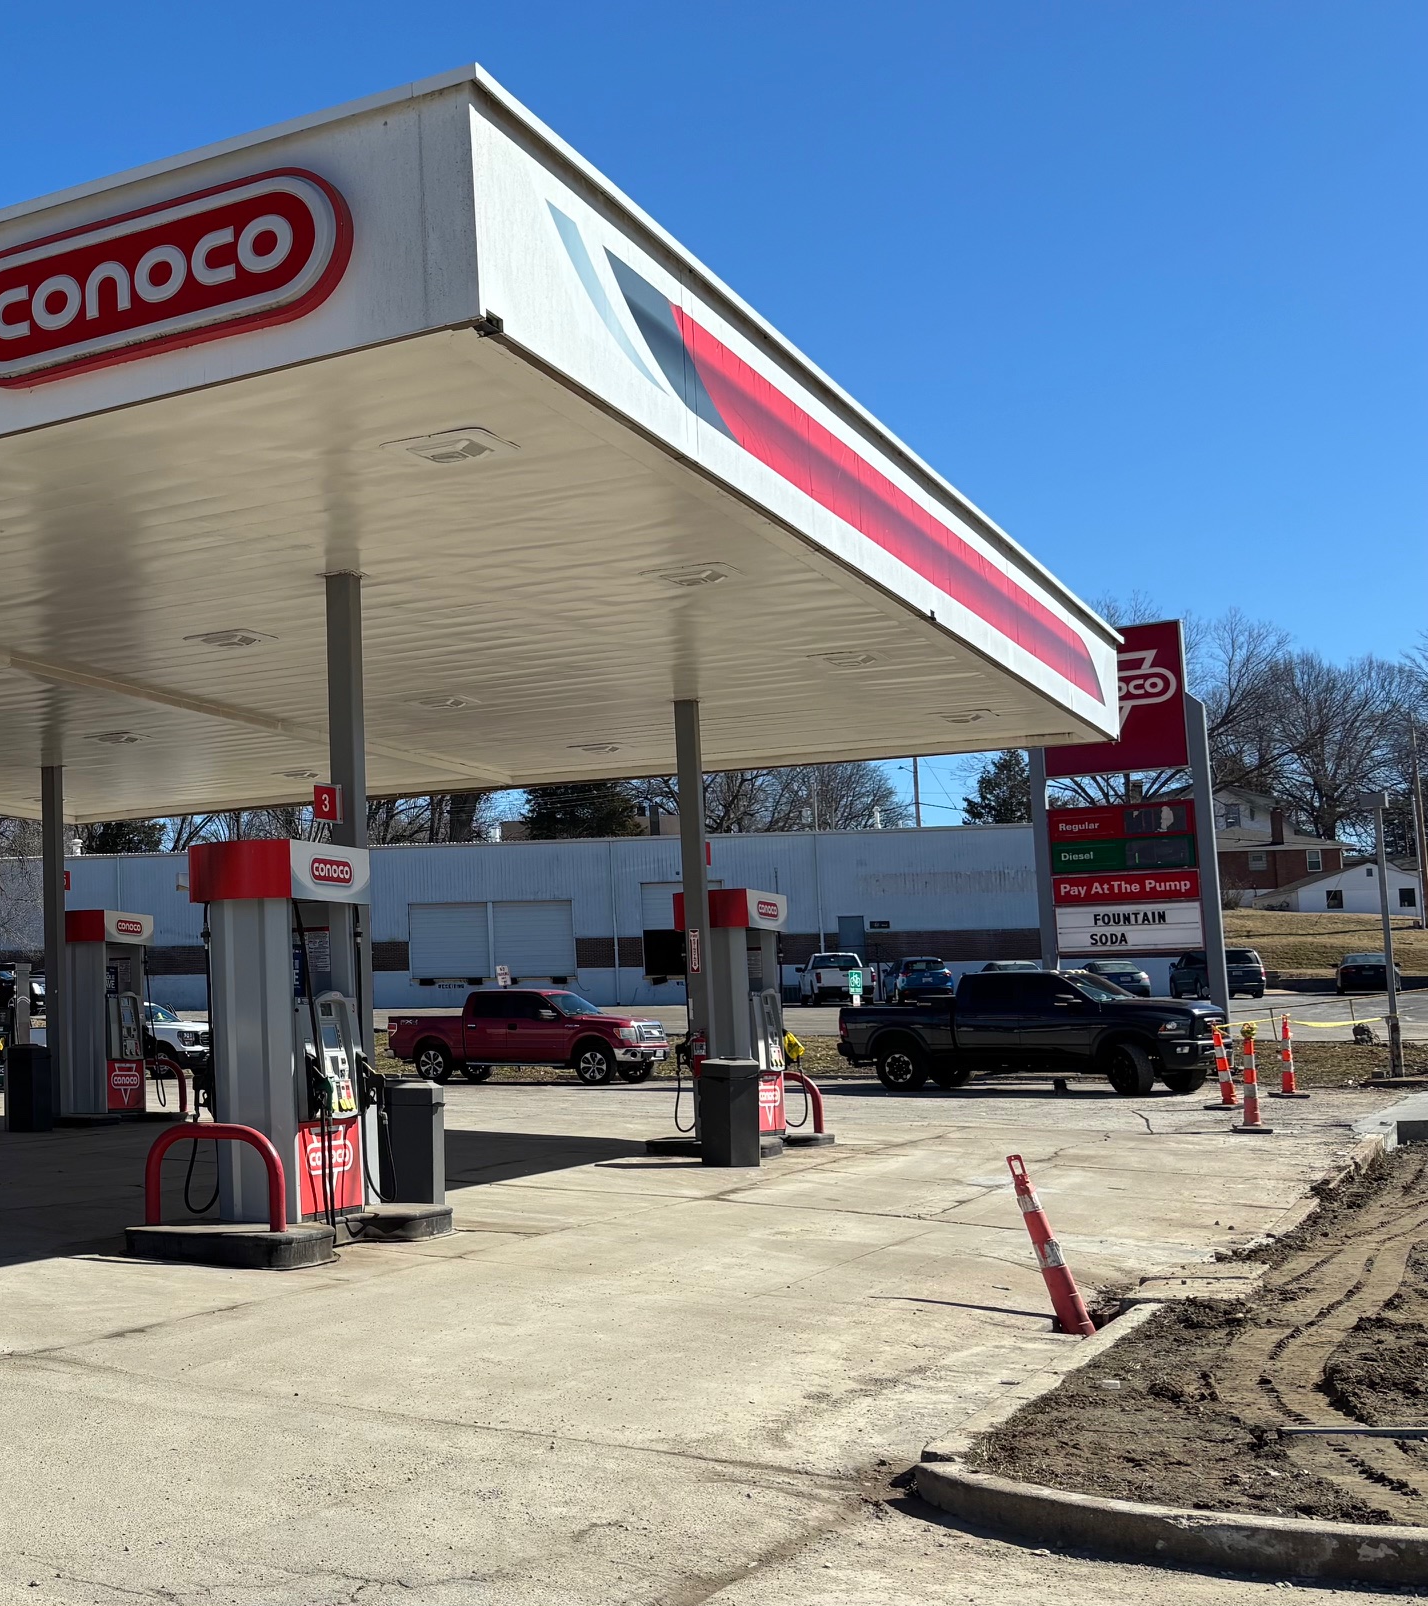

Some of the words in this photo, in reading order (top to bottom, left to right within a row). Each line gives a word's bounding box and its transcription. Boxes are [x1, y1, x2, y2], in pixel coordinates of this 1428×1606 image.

[321, 793, 330, 812] 3
[1058, 822, 1100, 832] Regular
[1061, 851, 1094, 861] Diesel
[1060, 884, 1087, 898] Pay
[1090, 882, 1110, 895] At
[1110, 881, 1141, 893] The
[1145, 879, 1191, 893] Pump
[1093, 911, 1167, 926] FOUNTAIN
[1089, 932, 1128, 946] SODA
